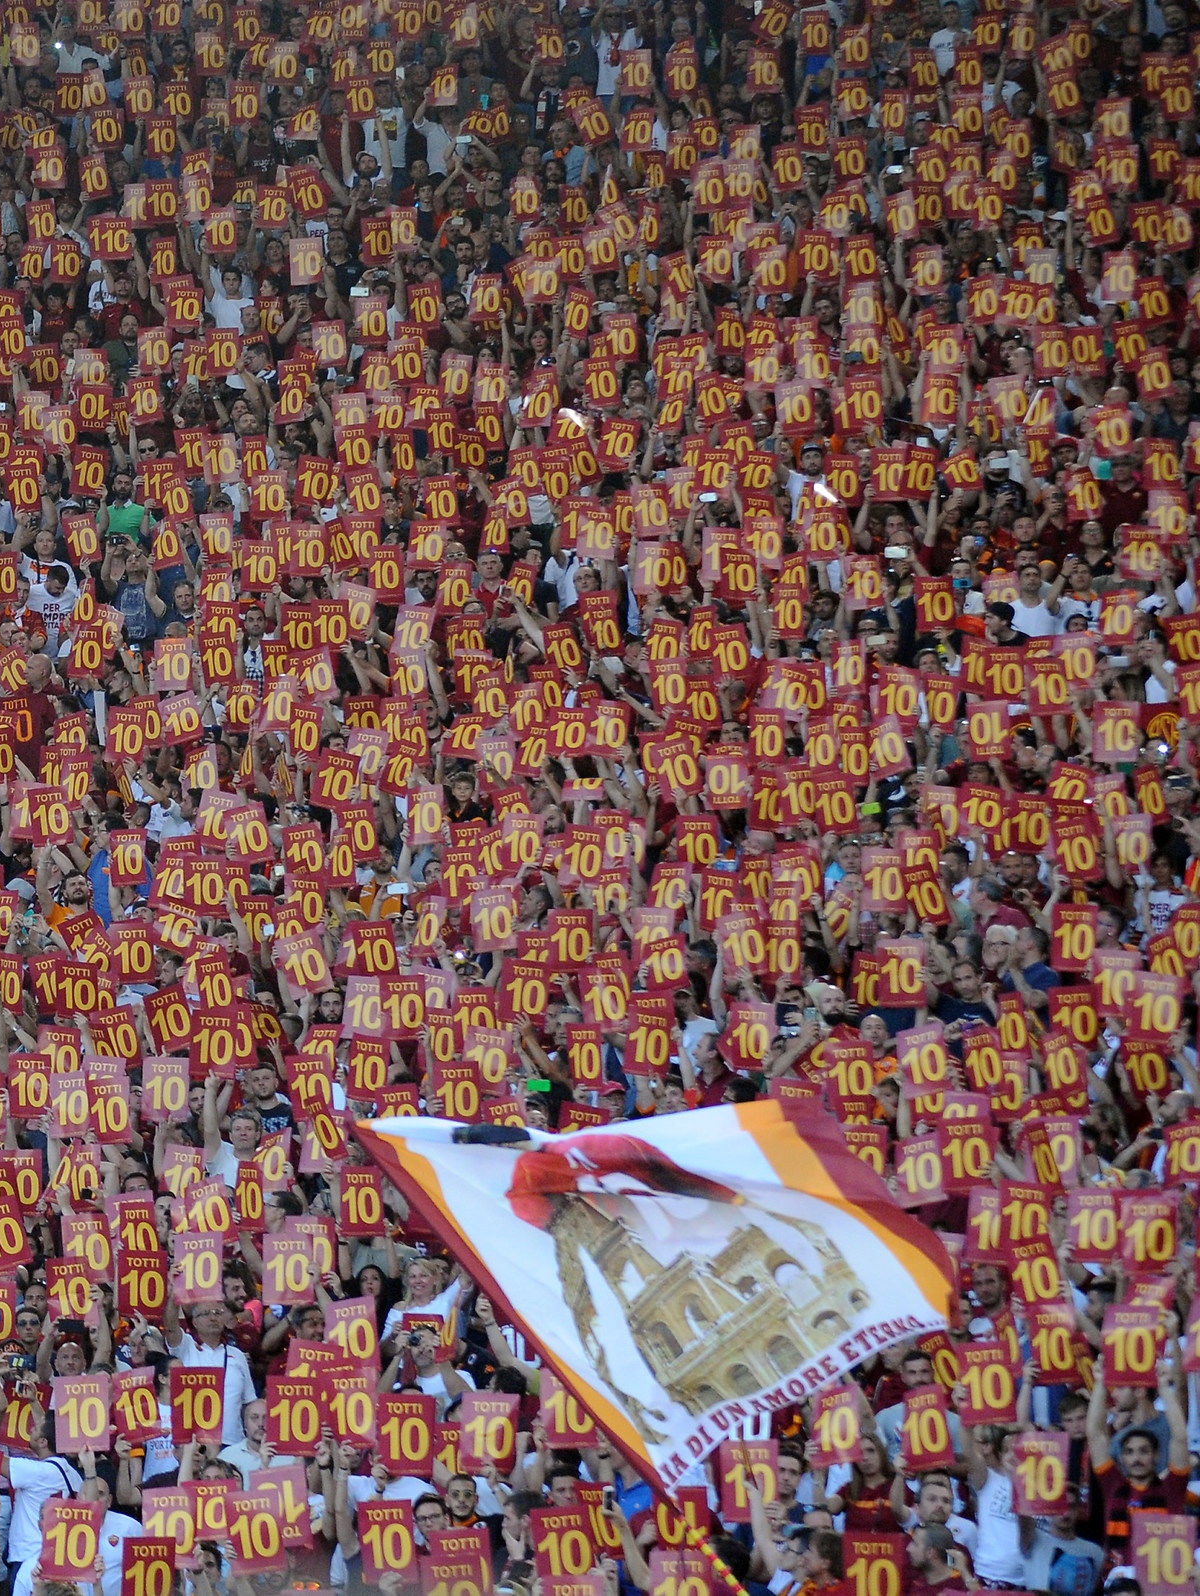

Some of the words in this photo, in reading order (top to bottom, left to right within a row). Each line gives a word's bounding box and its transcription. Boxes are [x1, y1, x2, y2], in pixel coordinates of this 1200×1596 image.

[623, 62, 650, 87] 10
[750, 59, 778, 85] 10
[235, 85, 255, 93] TOTTI
[347, 87, 374, 112] 10
[232, 94, 258, 118] 10
[835, 149, 864, 175] 10
[32, 203, 52, 211] TOTTI
[30, 212, 55, 237] 10
[310, 230, 325, 238] PER
[913, 259, 941, 286] 10
[143, 329, 166, 339] TOTTI
[142, 340, 170, 365] 10
[343, 428, 365, 437] TOTTI
[81, 450, 103, 460] TOTTI
[339, 438, 370, 466] 10
[76, 461, 104, 488] 10
[370, 560, 399, 588] 10
[922, 581, 948, 591] TOTTI
[43, 604, 60, 612] PER
[919, 592, 953, 621] 10
[990, 652, 1018, 661] TOTTI
[987, 663, 1023, 694] 10
[3, 698, 28, 710] TOTTI
[116, 712, 140, 721] TOTTI
[110, 723, 143, 754] 10
[116, 833, 142, 842] TOTTI
[684, 821, 712, 832] TOTTI
[113, 844, 142, 875] 10
[680, 833, 717, 864] 10
[871, 854, 900, 865] TOTTI
[865, 867, 904, 901] 10
[1060, 910, 1092, 922] TOTTI
[1150, 903, 1169, 911] PER
[118, 928, 148, 940] TOTTI
[1055, 923, 1094, 960] 10
[115, 941, 152, 974] 10
[387, 981, 418, 990] TOTTI
[199, 1015, 230, 1026] TOTTI
[384, 993, 423, 1028] 10
[638, 1012, 668, 1025] TOTTI
[193, 1028, 234, 1064] 10
[630, 1026, 668, 1065] 10
[152, 1062, 183, 1075] TOTTI
[147, 1076, 186, 1110] 10
[127, 1256, 160, 1268] TOTTI
[1014, 1243, 1046, 1256] TOTTI
[122, 1270, 164, 1308] 10
[1013, 1257, 1059, 1302] 10
[181, 1374, 217, 1385] TOTTI
[174, 1388, 221, 1429] 10
[387, 1402, 424, 1415] TOTTI
[685, 1425, 713, 1457] DI
[709, 1402, 747, 1431] UN
[748, 1355, 840, 1414] AMORE
[909, 1393, 938, 1408] TOTTI
[382, 1417, 429, 1460] 10
[815, 1407, 856, 1452] 10
[905, 1409, 947, 1455] 10
[1018, 1455, 1064, 1501] 10
[55, 1507, 93, 1520] TOTTI
[366, 1508, 404, 1522] TOTTI
[47, 1522, 96, 1567] 10
[363, 1524, 412, 1568] 10
